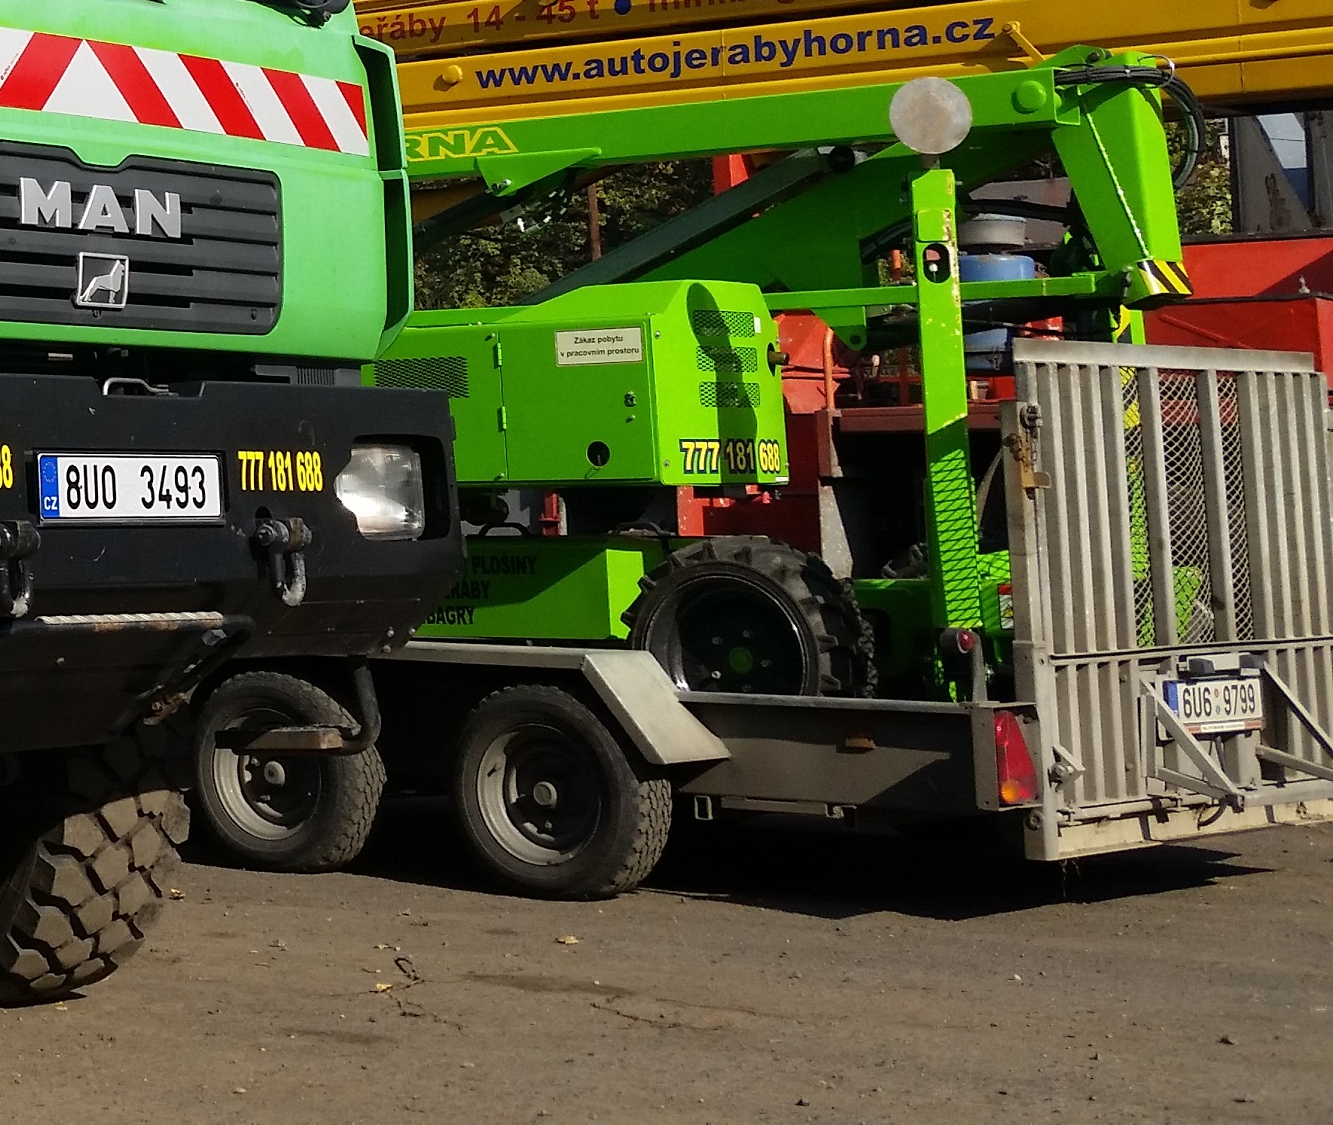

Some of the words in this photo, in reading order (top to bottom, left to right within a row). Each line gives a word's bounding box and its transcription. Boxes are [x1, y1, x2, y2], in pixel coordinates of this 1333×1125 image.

[467, 5, 502, 33] 14
[476, 17, 995, 89] www.autojerabyhorna.cz
[19, 177, 181, 238] MAN
[598, 335, 623, 344] pobytu
[607, 347, 639, 356] prostoru
[238, 451, 264, 491] 777
[268, 451, 293, 491] 181
[296, 451, 323, 492] 688
[680, 439, 720, 473] 777
[725, 440, 755, 473] 181
[758, 440, 781, 473] 688
[44, 497, 58, 511] CZ
[140, 465, 206, 510] 3493
[472, 551, 536, 575] PLOŠINY
[1182, 686, 1212, 718] 6U6
[1223, 683, 1255, 715] 9799
